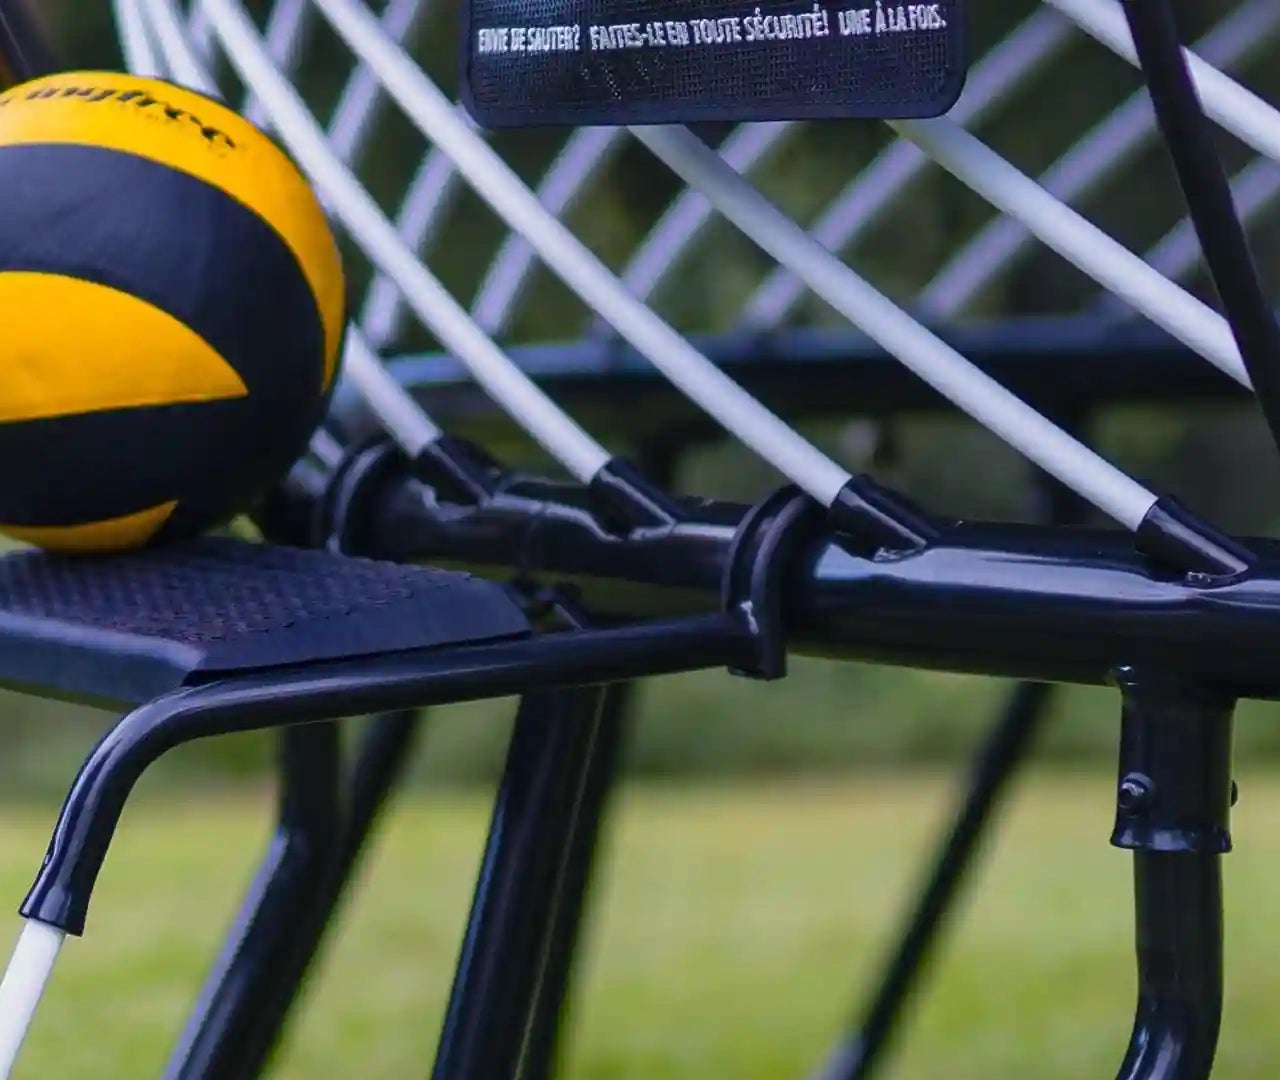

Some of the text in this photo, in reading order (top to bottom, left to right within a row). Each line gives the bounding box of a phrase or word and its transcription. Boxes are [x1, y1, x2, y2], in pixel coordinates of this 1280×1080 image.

[510, 27, 526, 52] DE
[527, 24, 580, 52] SAUTER?
[589, 22, 666, 50] FAITES-LE
[666, 20, 690, 45] EN
[690, 18, 742, 44] TOUTE
[743, 3, 829, 41] SÉCURITÉ!
[838, 8, 871, 36] UNE
[875, 0, 886, 34] À
[887, 6, 908, 32] LA
[908, 4, 947, 31] FOIS.
